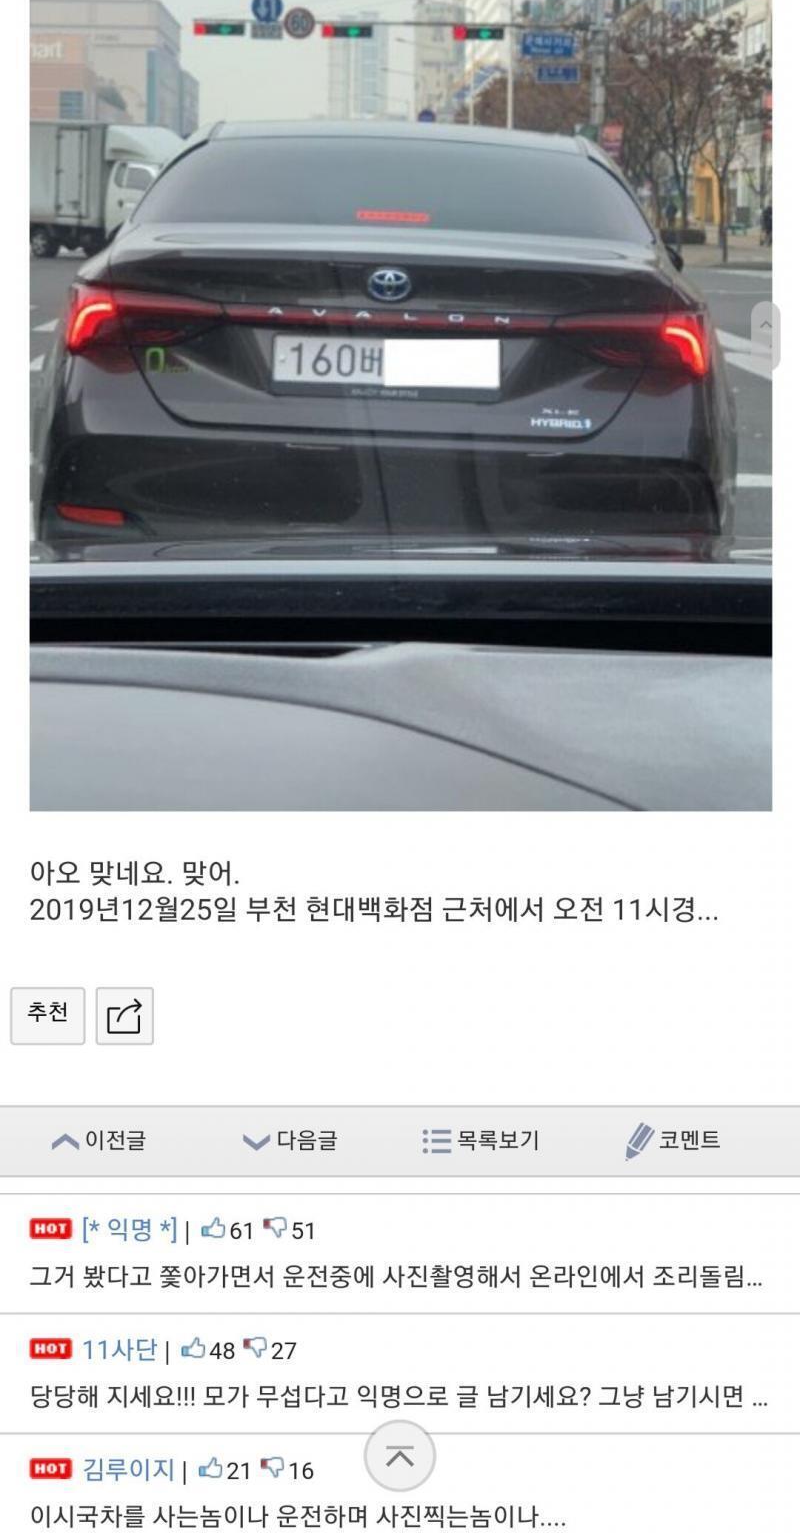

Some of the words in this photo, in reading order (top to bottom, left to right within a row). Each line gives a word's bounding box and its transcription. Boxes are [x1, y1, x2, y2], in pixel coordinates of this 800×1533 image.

[267, 306, 511, 325] AVALON
[30, 860, 81, 887] 아오
[90, 860, 173, 887] 맞네요.
[183, 860, 240, 887] 맞어.
[29, 896, 237, 923] 2019년12월25일
[245, 896, 296, 923] 부천
[306, 896, 432, 923] 현대백화점
[442, 896, 543, 923] 근처에서
[553, 896, 603, 923] 오전
[613, 896, 718, 923] 11시경...
[27, 1001, 68, 1023] 추천
[85, 1129, 147, 1151] 이전글
[277, 1129, 338, 1151] 다음글
[457, 1129, 538, 1153] 목록보기
[659, 1129, 721, 1151] 코멘트
[107, 1218, 151, 1242] 익명
[229, 1221, 254, 1240] 61
[291, 1221, 315, 1240] 51
[29, 1264, 76, 1289] 그거
[83, 1264, 152, 1289] 봤다고
[159, 1264, 274, 1289] 쫓아가면서
[282, 1264, 374, 1289] 운전중에
[382, 1264, 521, 1289] 사진촬영해서
[529, 1264, 644, 1289] 온라인에서
[652, 1264, 763, 1289] 조리돌림...
[83, 1338, 158, 1362] 11사단
[209, 1341, 236, 1360] 48
[271, 1341, 297, 1360] 27
[31, 1384, 98, 1409] 당당해
[106, 1384, 195, 1409] 지세요!!!
[203, 1384, 250, 1409] 모가
[256, 1384, 349, 1409] 무섭다고
[357, 1384, 449, 1409] 익명으로
[456, 1385, 479, 1409] 글
[487, 1384, 592, 1409] 남기세요?
[598, 1384, 645, 1409] 그냥
[653, 1384, 743, 1409] 남기시면
[83, 1458, 174, 1482] 김루이지
[226, 1461, 250, 1480] 21
[289, 1461, 314, 1480] 16
[30, 1504, 146, 1529] 이시국차를
[152, 1504, 270, 1529] 사는놈이나
[276, 1504, 367, 1529] 운전하며
[375, 1504, 566, 1529] 사진찍는놈이나....
